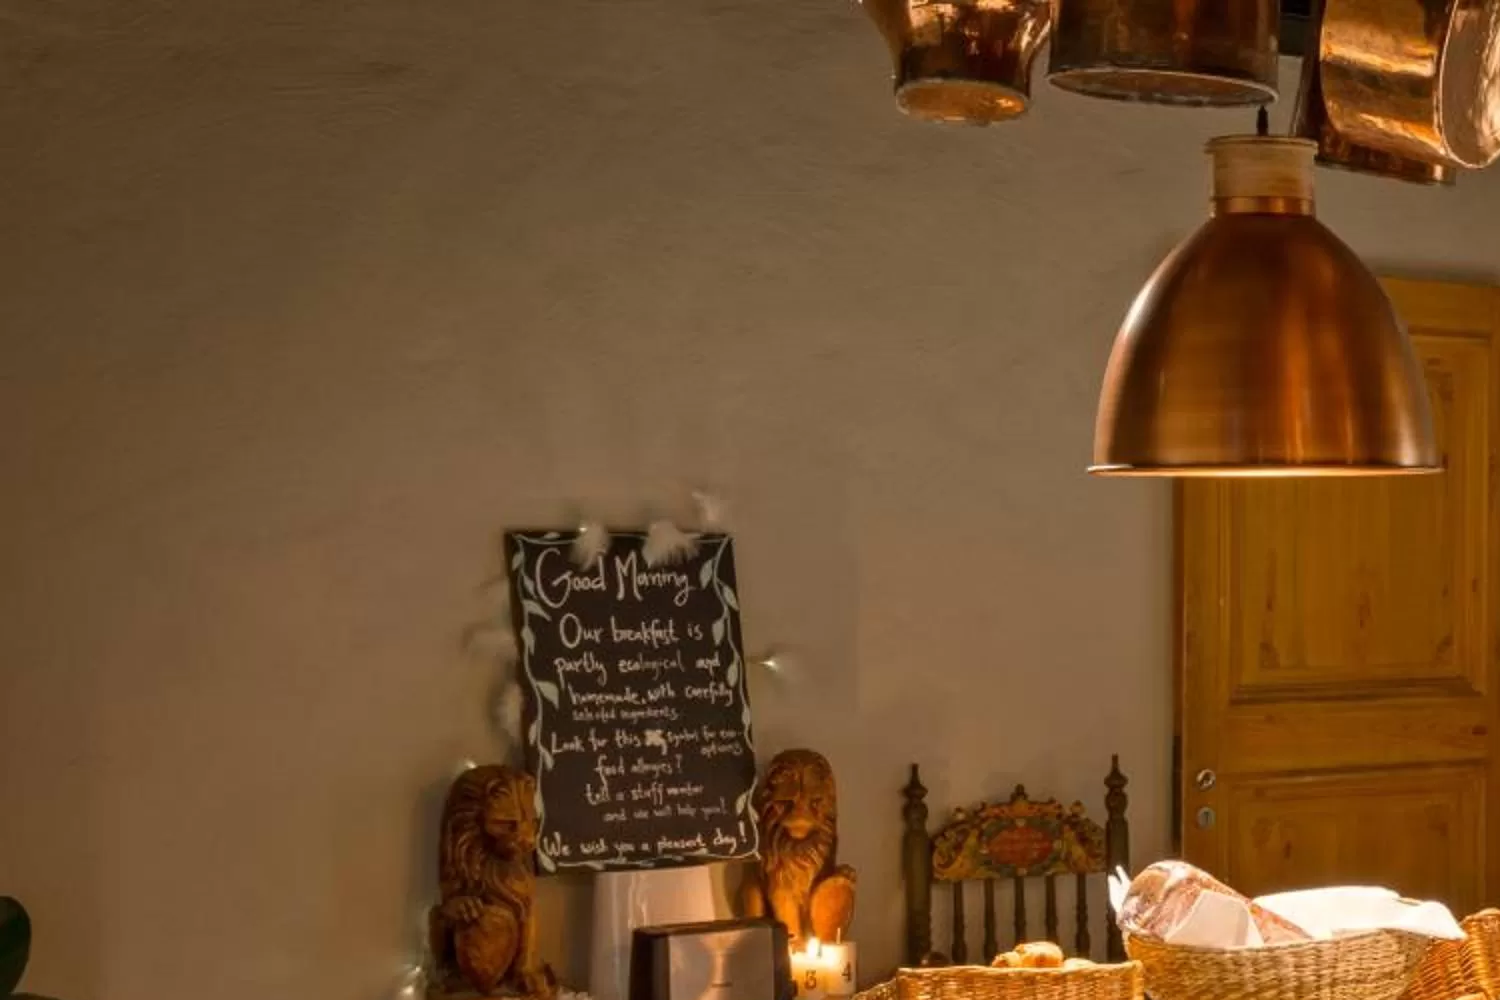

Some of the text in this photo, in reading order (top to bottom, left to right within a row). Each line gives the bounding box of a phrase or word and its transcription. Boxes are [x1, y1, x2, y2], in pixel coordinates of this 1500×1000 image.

[535, 548, 606, 608] Good
[559, 613, 704, 649] Our breakfast is
[553, 650, 721, 690] partly ecological and
[646, 681, 676, 700] with
[551, 731, 584, 754] Look
[588, 728, 608, 751] for
[615, 728, 642, 746] this
[630, 783, 665, 806] staff
[543, 831, 572, 858] We
[579, 837, 608, 855] wish
[657, 833, 707, 855] pleasant
[804, 969, 817, 990] 3
[840, 960, 851, 982] 4
